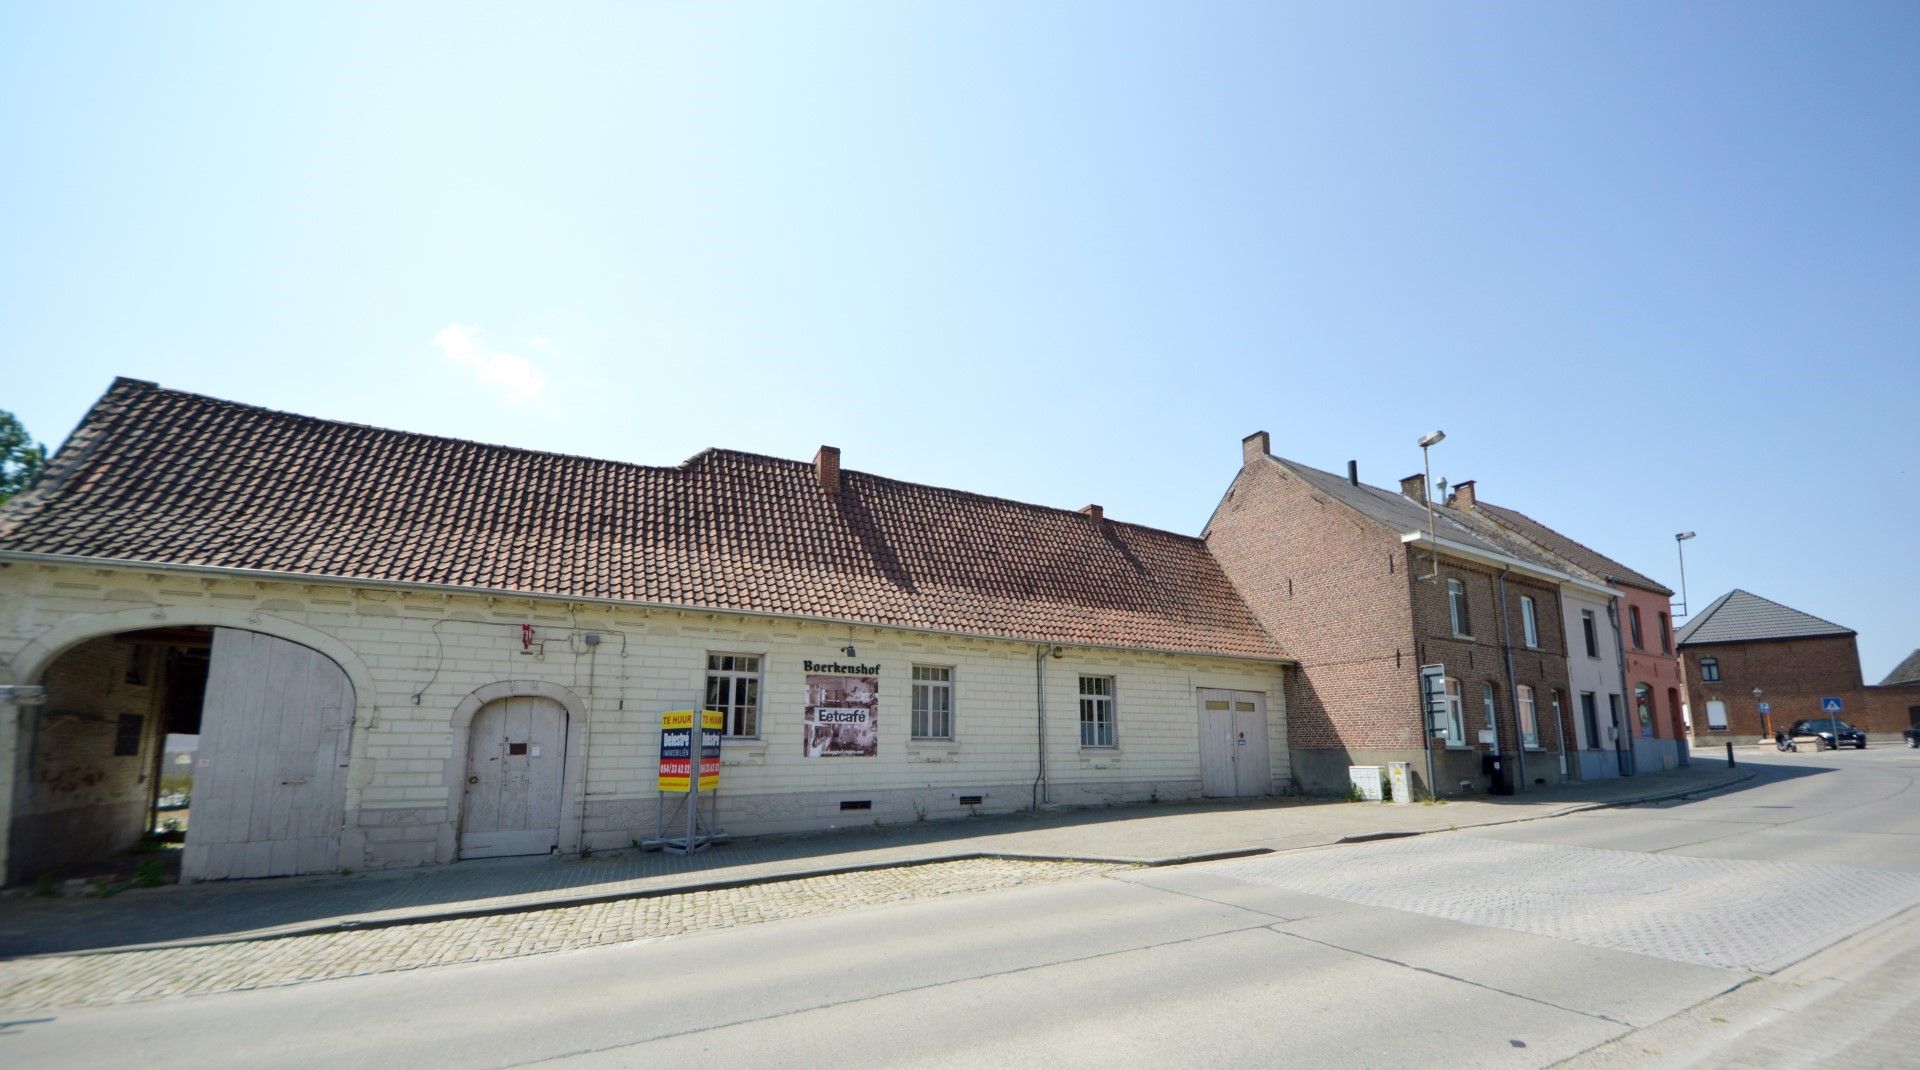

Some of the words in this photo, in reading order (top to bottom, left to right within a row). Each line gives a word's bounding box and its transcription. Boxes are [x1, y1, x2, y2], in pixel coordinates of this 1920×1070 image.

[803, 660, 881, 675] Boerkenshof
[663, 716, 671, 724] TE
[672, 714, 692, 724] HUUR
[703, 715, 709, 723] TE
[818, 709, 866, 723] Eetcafé
